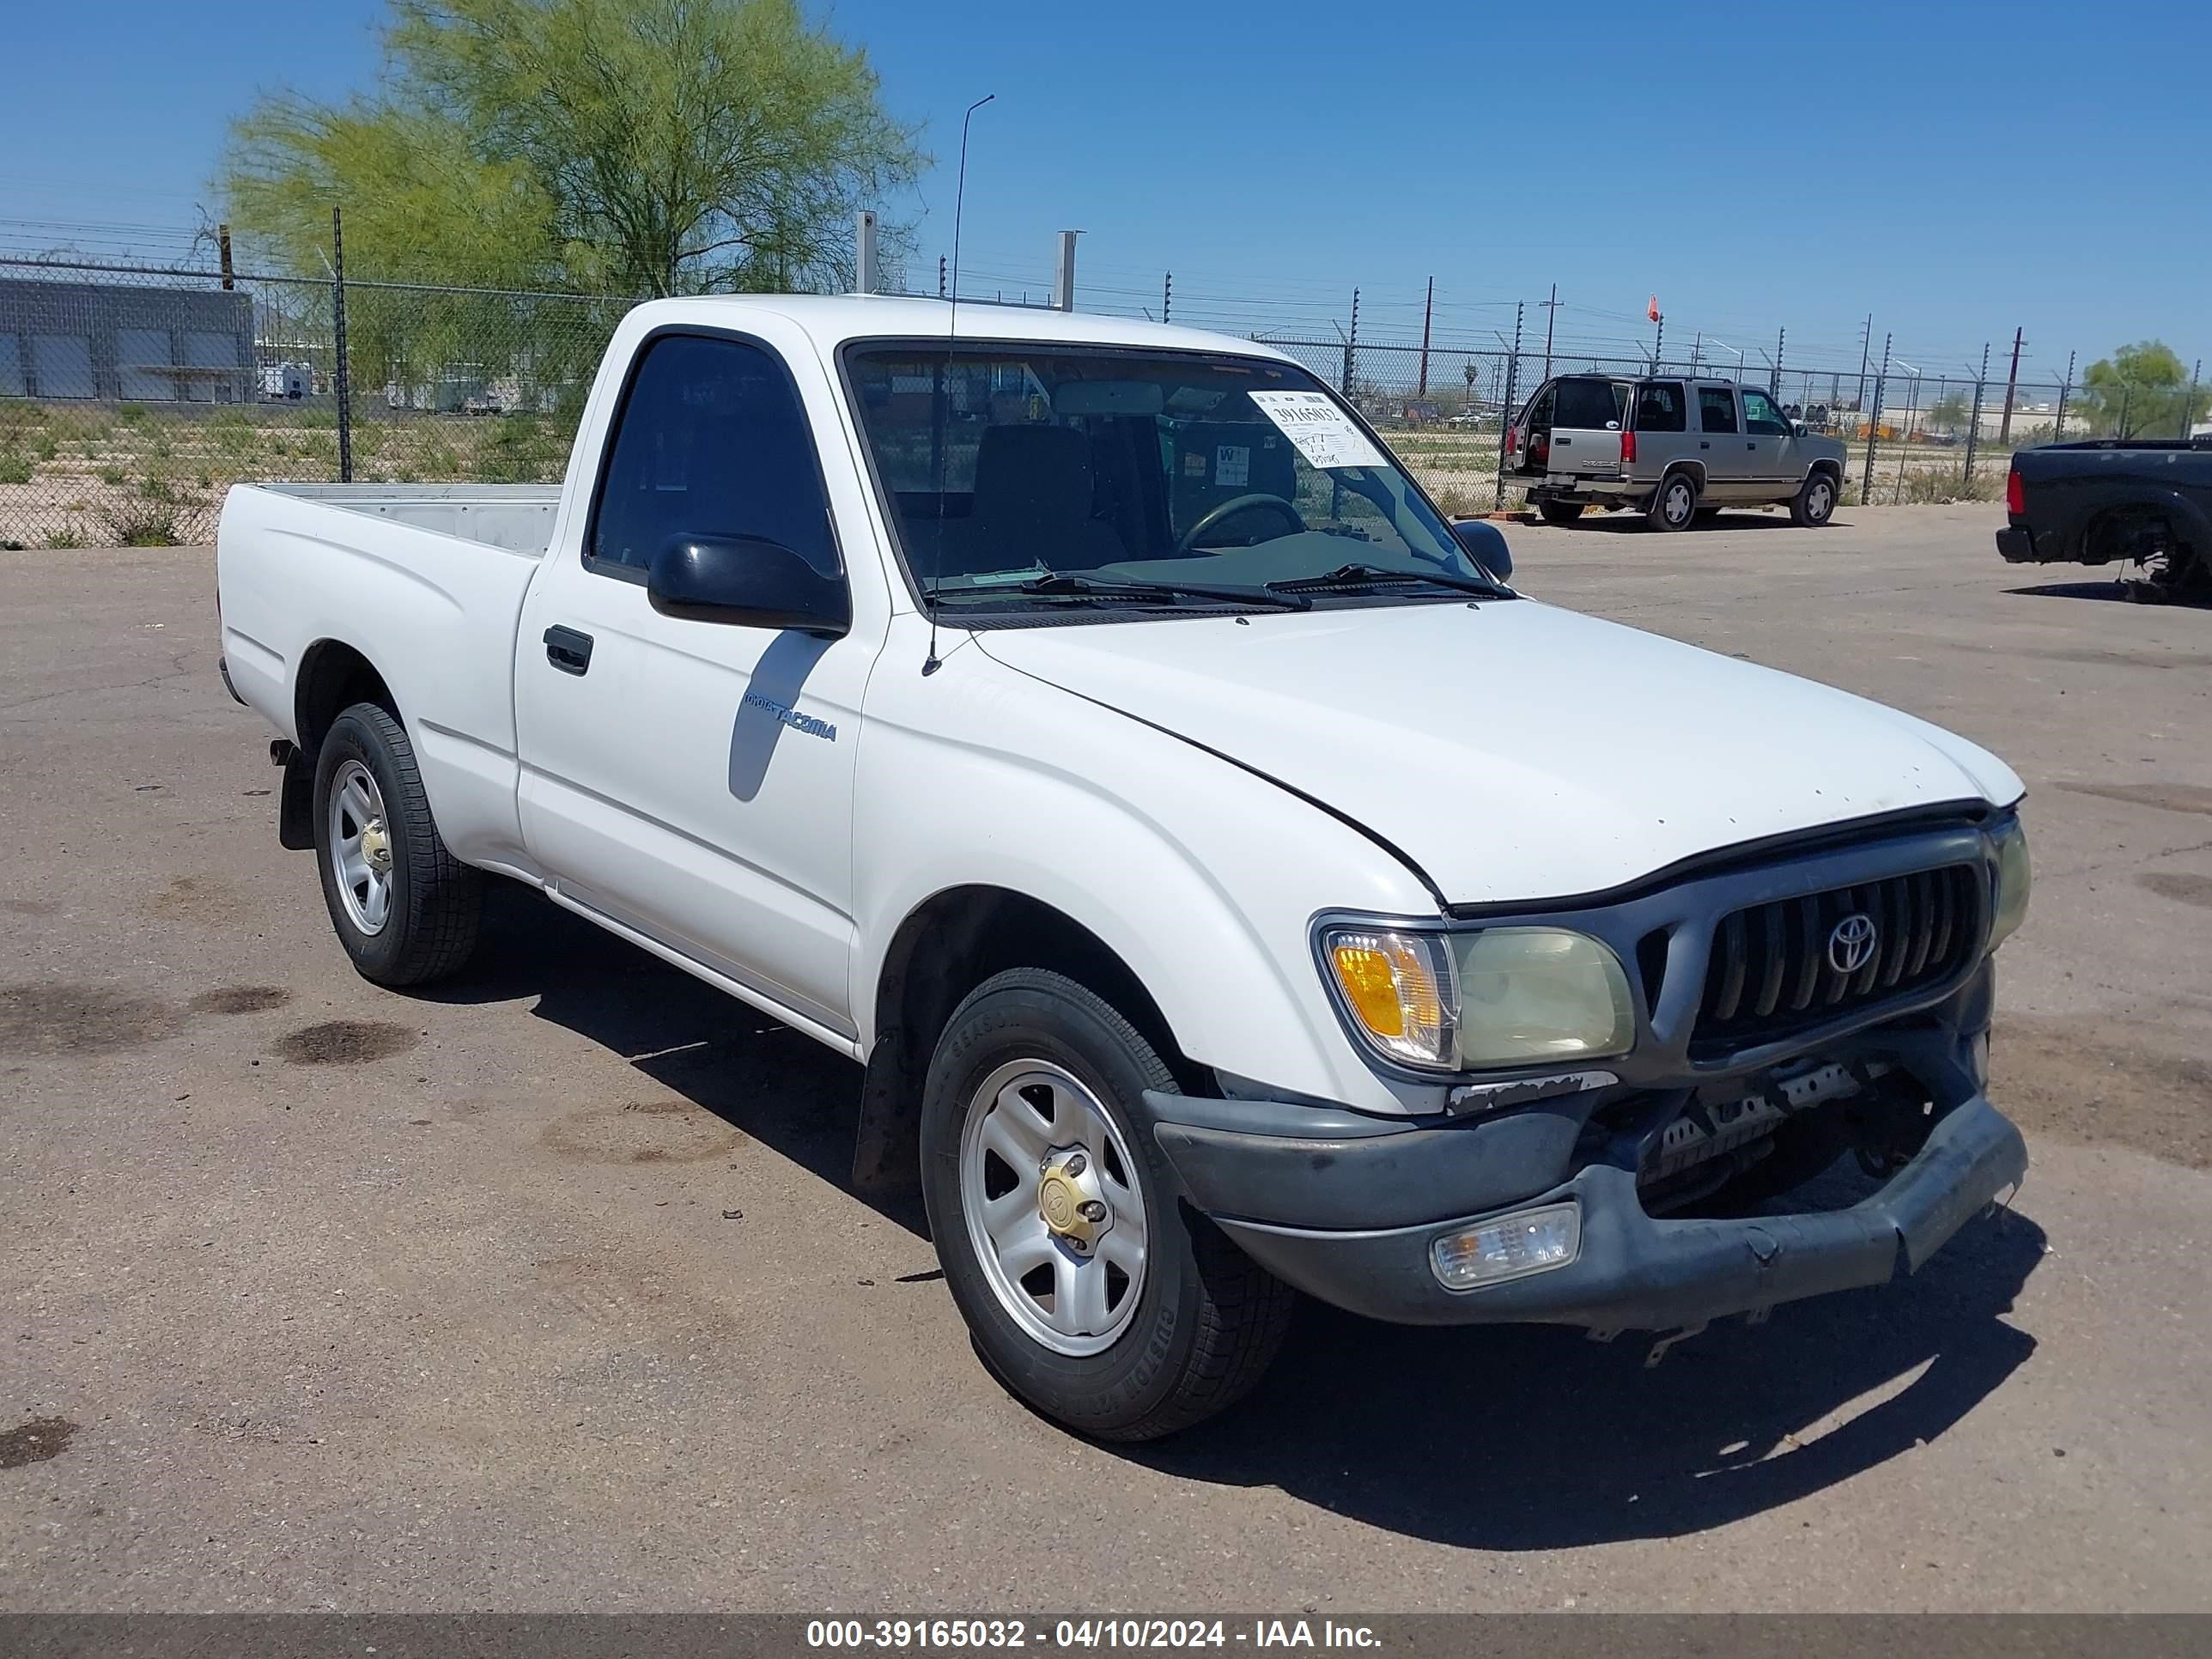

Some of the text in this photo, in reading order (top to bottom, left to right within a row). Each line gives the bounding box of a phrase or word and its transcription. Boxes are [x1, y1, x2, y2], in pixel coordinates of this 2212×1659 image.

[1273, 407, 1340, 422] 39165032
[744, 693, 837, 743] TOYOTA TACOMA
